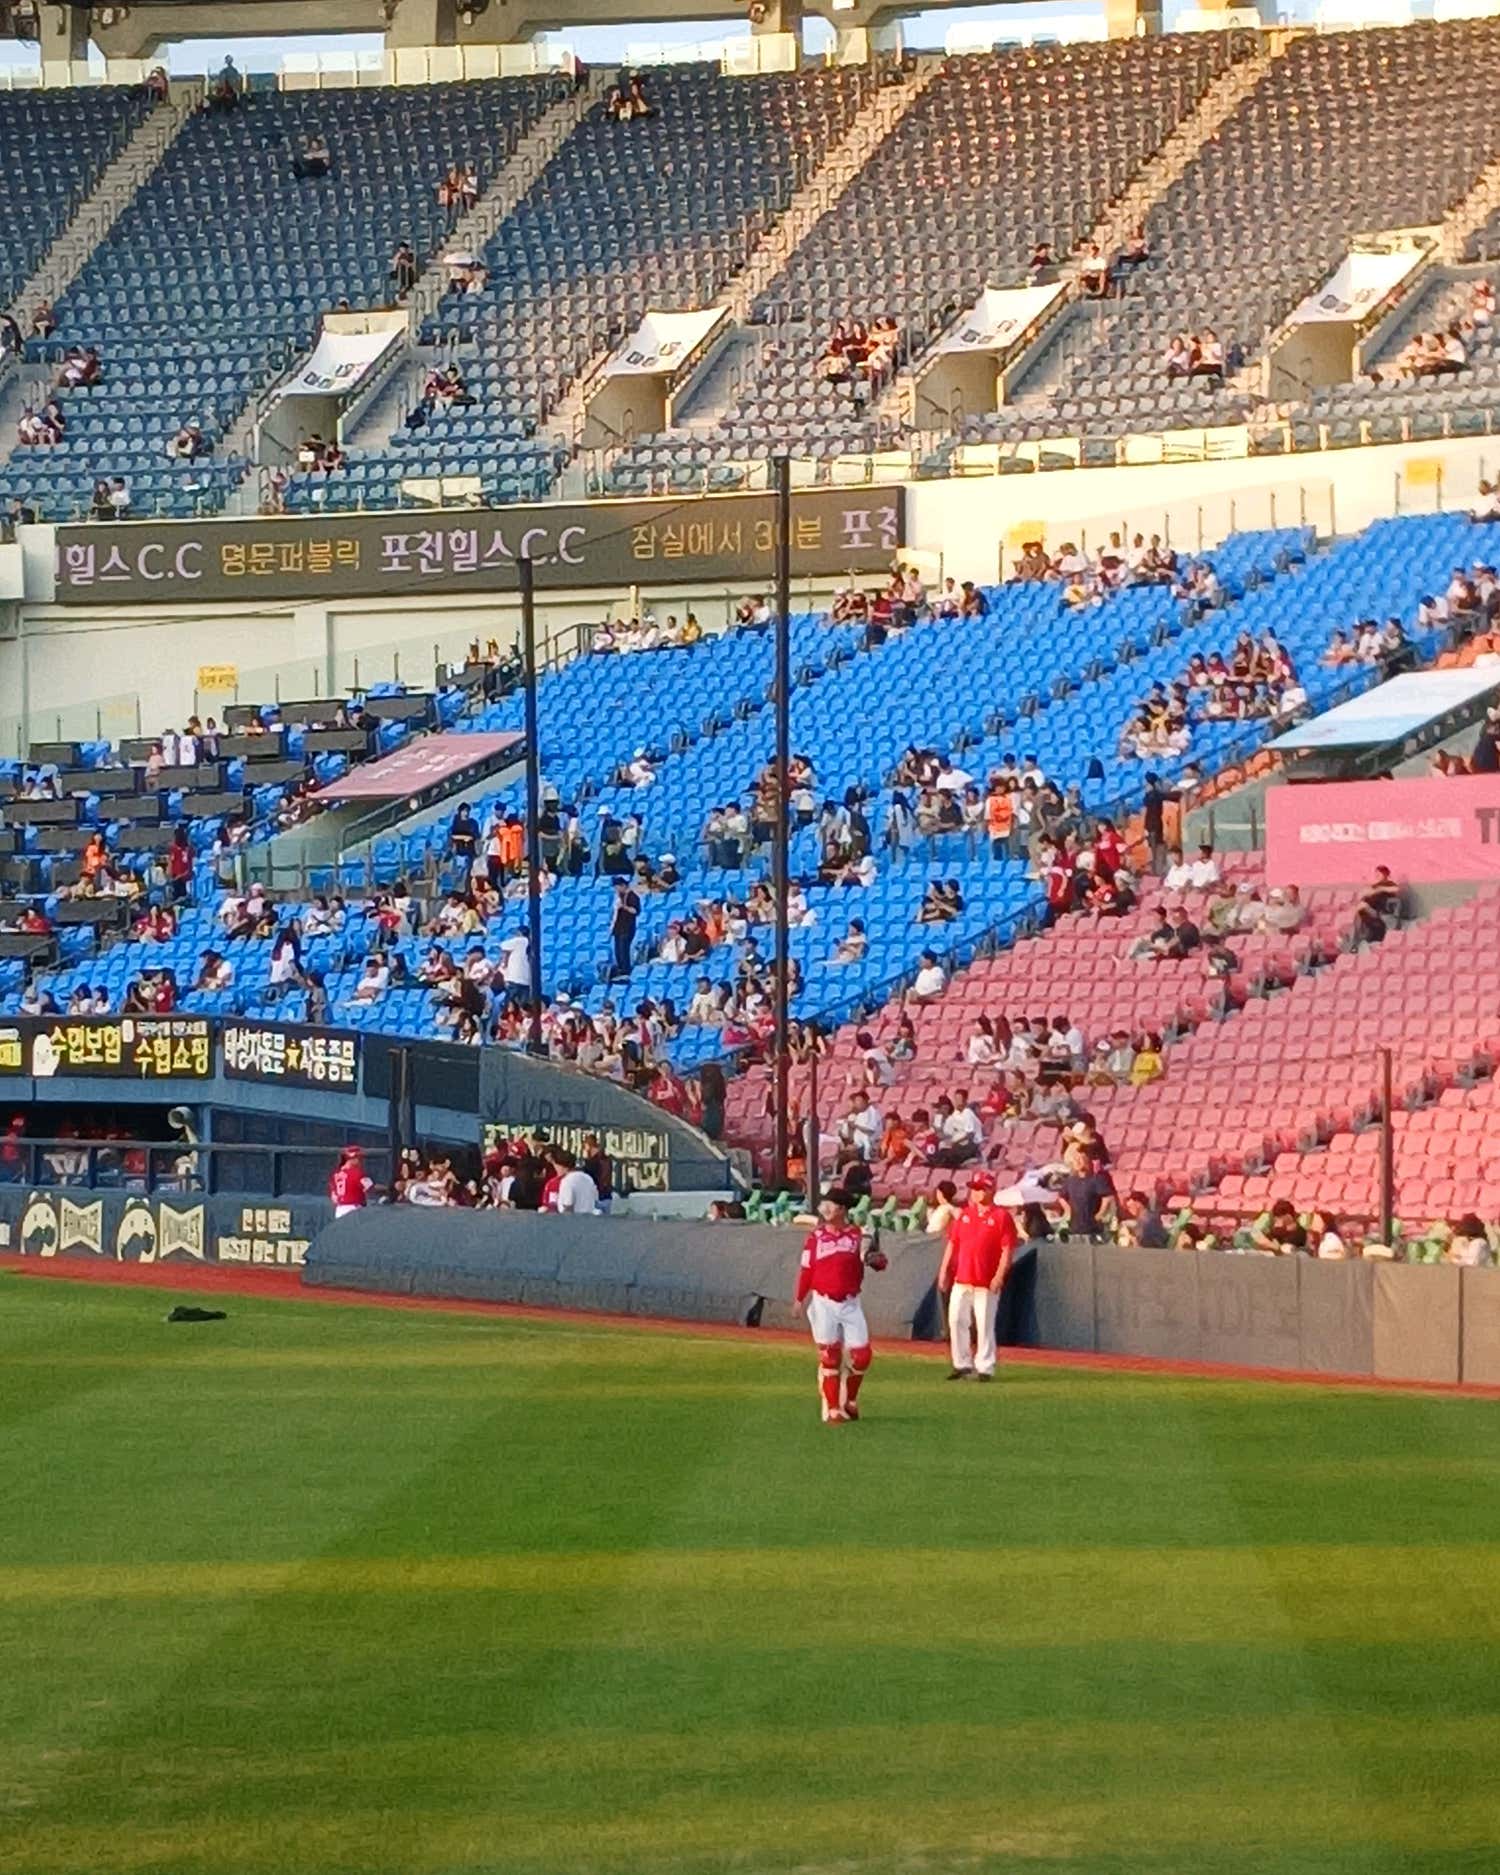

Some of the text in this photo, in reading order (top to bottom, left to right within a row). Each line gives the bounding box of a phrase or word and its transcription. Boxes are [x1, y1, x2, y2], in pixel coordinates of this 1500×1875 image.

[54, 542, 203, 585] 힐스C.C
[631, 520, 741, 559] 잠실에서
[754, 514, 823, 551] 3분
